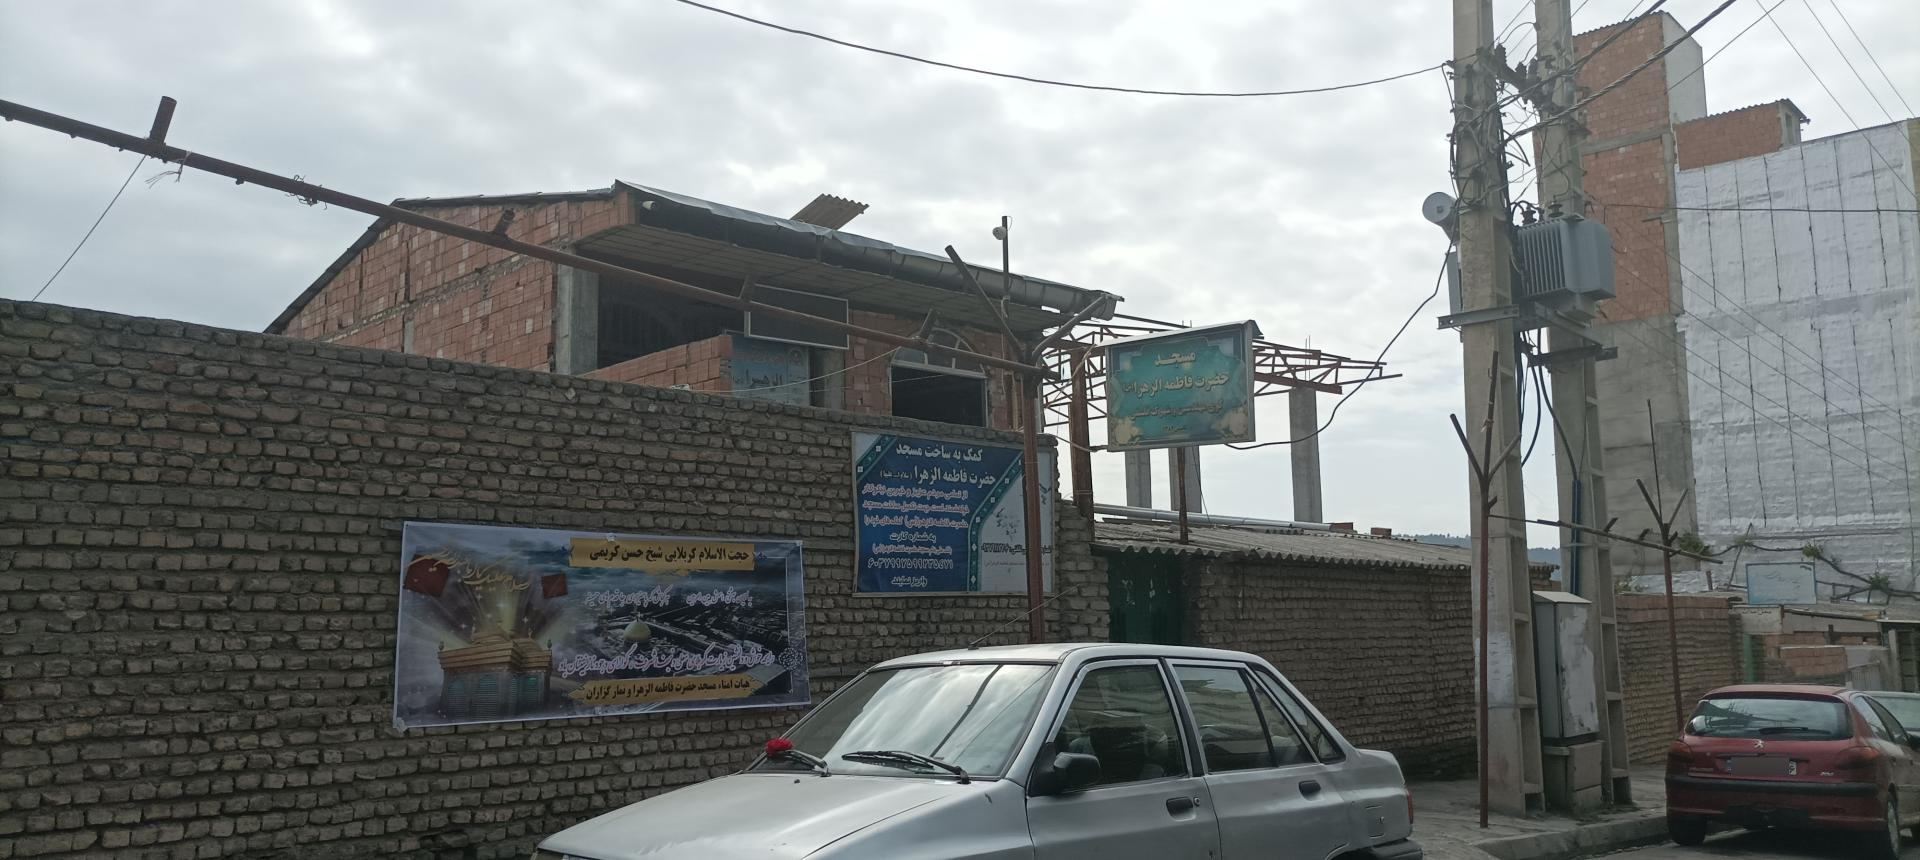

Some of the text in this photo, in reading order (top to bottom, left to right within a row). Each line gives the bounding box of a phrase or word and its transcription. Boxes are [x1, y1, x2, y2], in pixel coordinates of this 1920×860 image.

[1154, 351, 1197, 368] مسجد
[1164, 376, 1193, 391] فاطمه
[1194, 373, 1230, 392] حضرت
[896, 442, 983, 464] کمک به ساخت مسجد
[913, 465, 941, 485] الزهرا
[943, 467, 968, 484] فاطمه
[969, 472, 996, 489] حضرت
[589, 545, 750, 564] حجت الاسلام کربلایی شیخ حسن کریمی
[586, 684, 611, 700] گزاران
[626, 688, 633, 698] و
[632, 684, 654, 699] الزهرا
[654, 681, 674, 694] فاطمه
[675, 682, 697, 698] حضرت
[698, 682, 717, 694] مسجد
